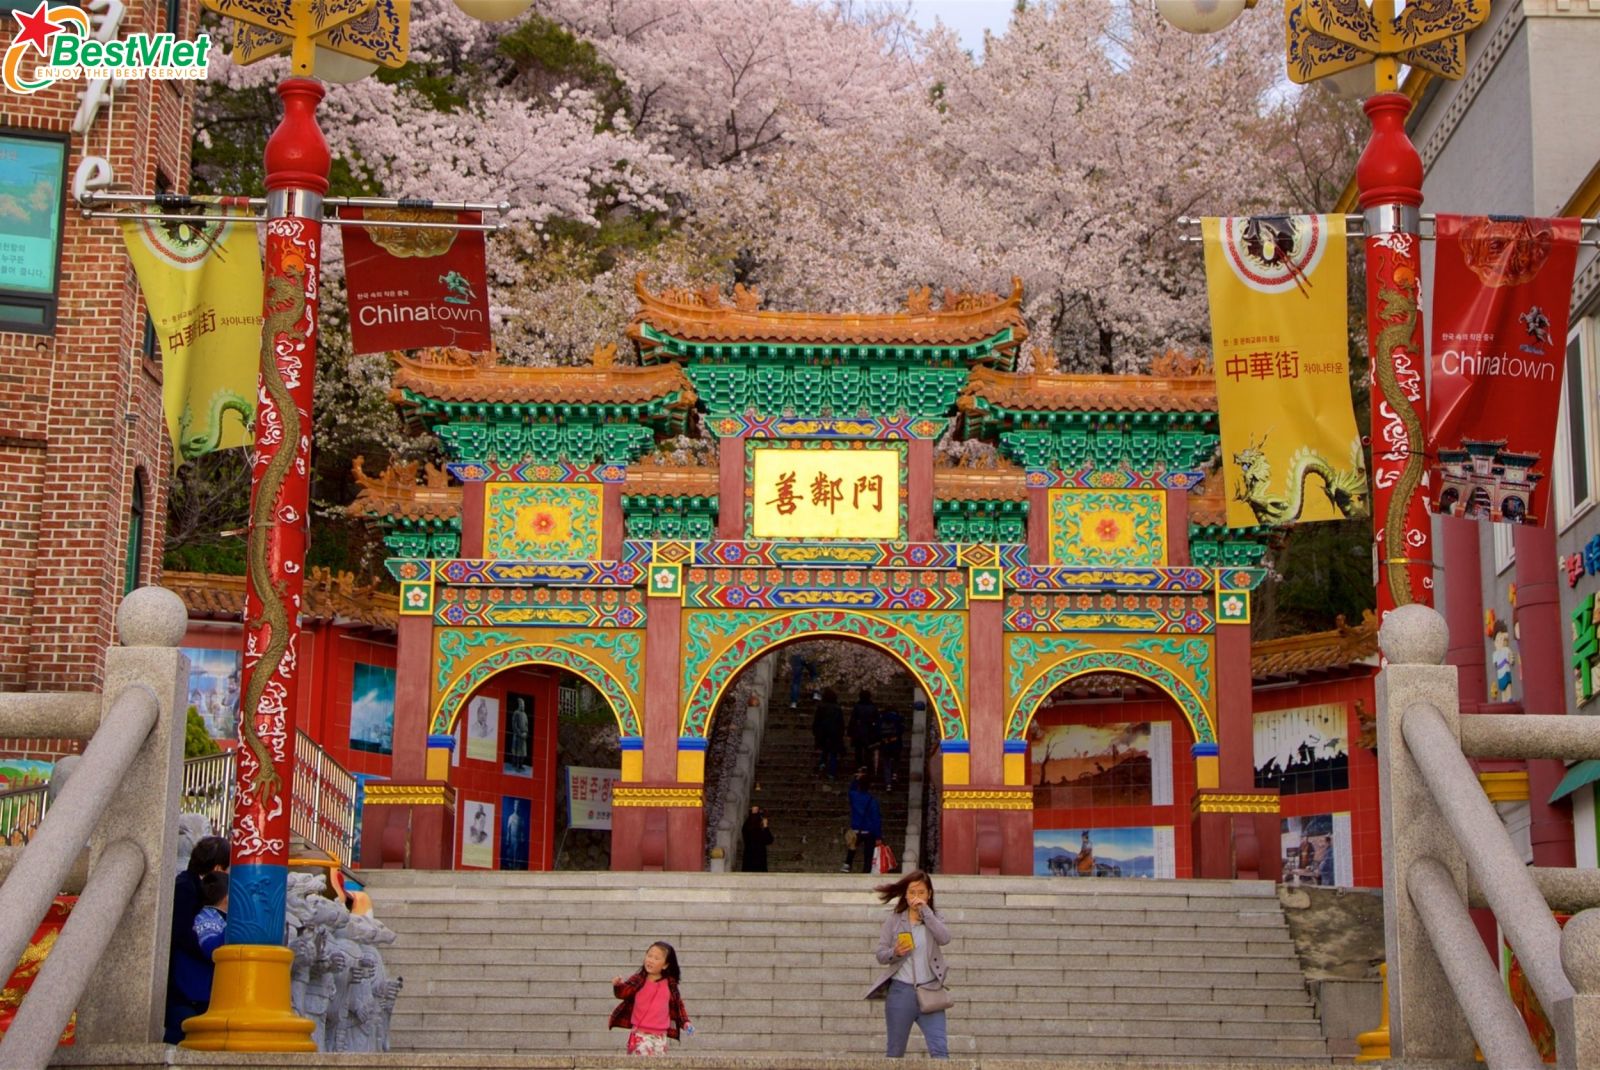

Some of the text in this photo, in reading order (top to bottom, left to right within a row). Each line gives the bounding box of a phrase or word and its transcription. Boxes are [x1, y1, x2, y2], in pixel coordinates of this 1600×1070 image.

[359, 303, 483, 326] Chinatown
[1225, 350, 1344, 382] 中華街 차이나타운
[1441, 349, 1555, 382] Chinatown
